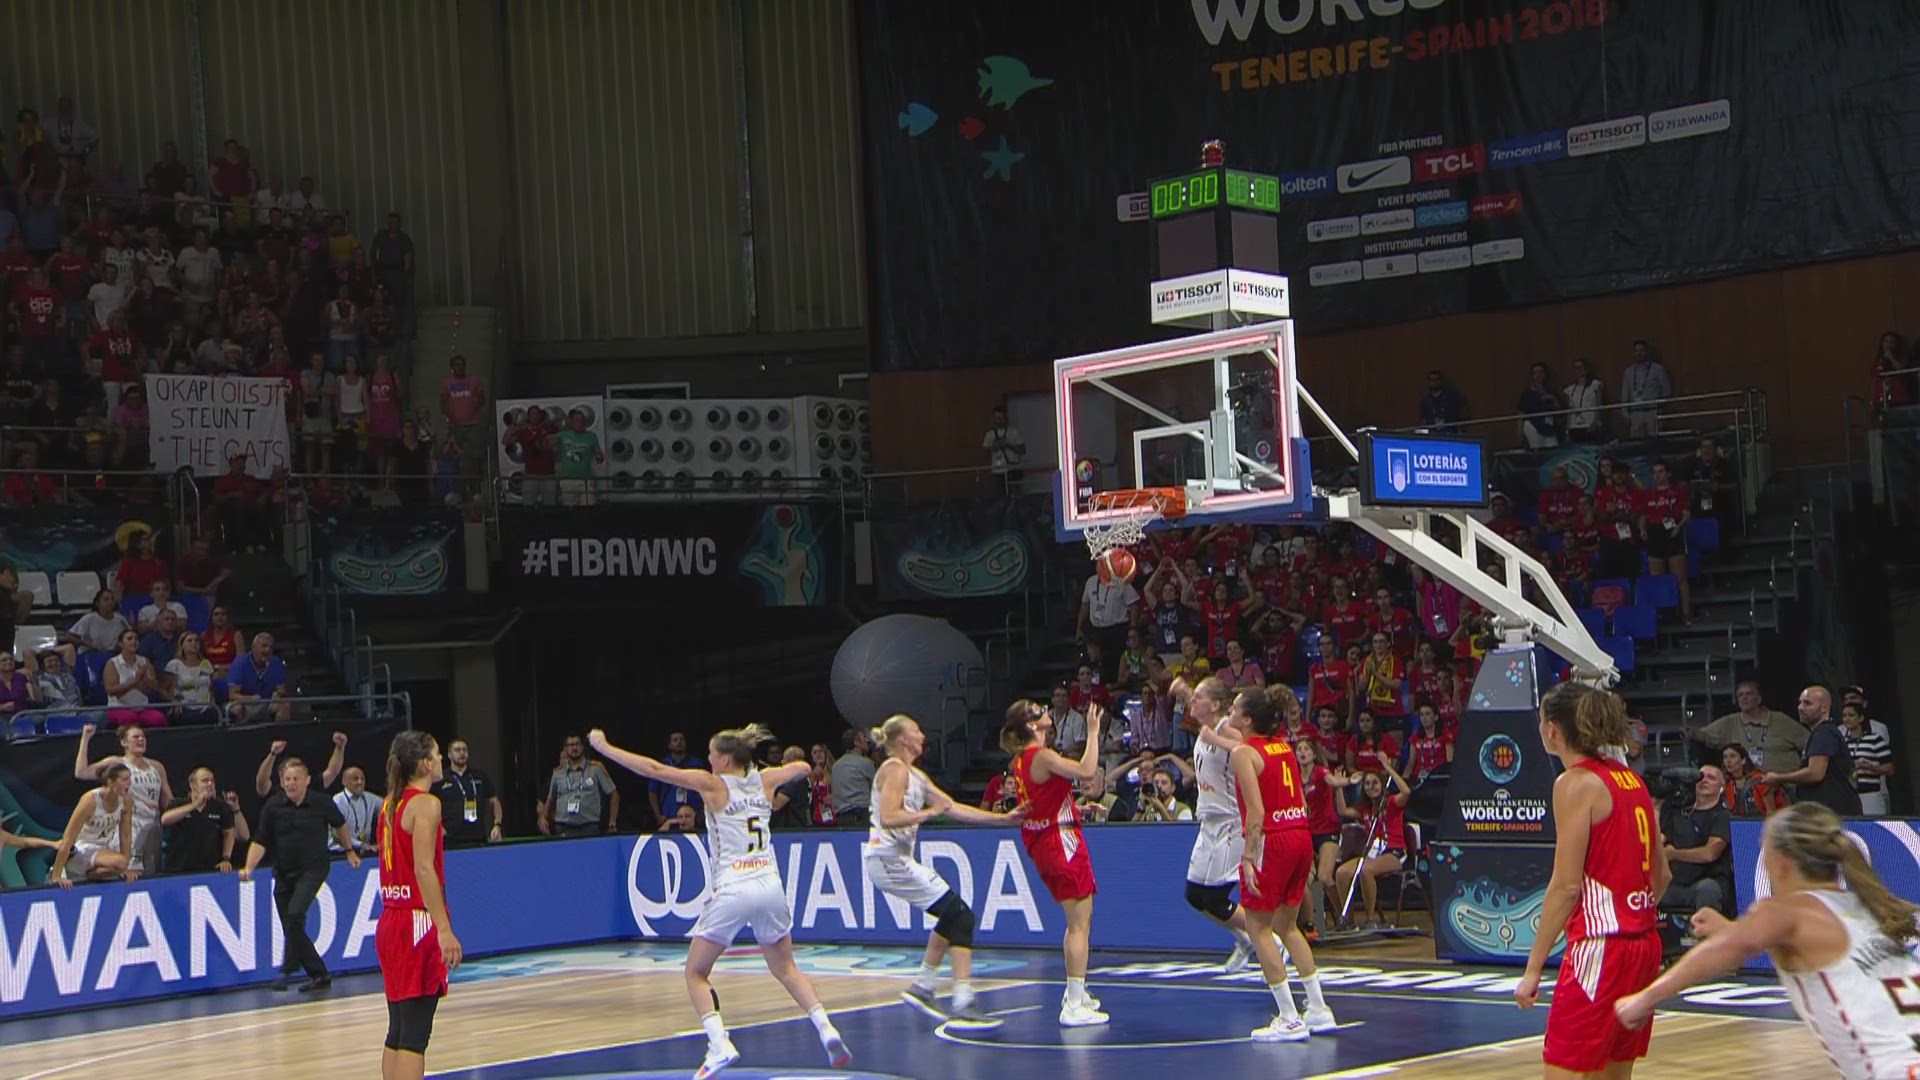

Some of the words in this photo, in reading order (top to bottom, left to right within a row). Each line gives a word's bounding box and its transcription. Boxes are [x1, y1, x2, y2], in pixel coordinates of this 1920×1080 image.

[1687, 110, 1728, 129] WANDA
[1590, 121, 1643, 141] TISSOT
[1400, 135, 1443, 151] PARTNERS
[1492, 144, 1542, 161] Tencent
[1426, 153, 1473, 175] TCL
[1155, 173, 1218, 215] 00:00
[1406, 188, 1451, 204] SPONSORS
[1363, 237, 1425, 255] INSTITUTIONAL
[1425, 231, 1468, 247] PARTNERS
[1175, 280, 1222, 300] TISSOT
[1247, 283, 1285, 299] TISSOT
[156, 377, 215, 402] OKAPI
[171, 407, 257, 430] STEUNT
[223, 438, 286, 468] CATS
[1413, 453, 1468, 471] LOTERÍAS
[522, 537, 717, 577] #FIBAWWC
[1282, 760, 1294, 799] 4
[1461, 807, 1514, 820] WORLD
[1516, 807, 1547, 820] CUP
[747, 815, 763, 853] 5
[1635, 806, 1651, 872] 9
